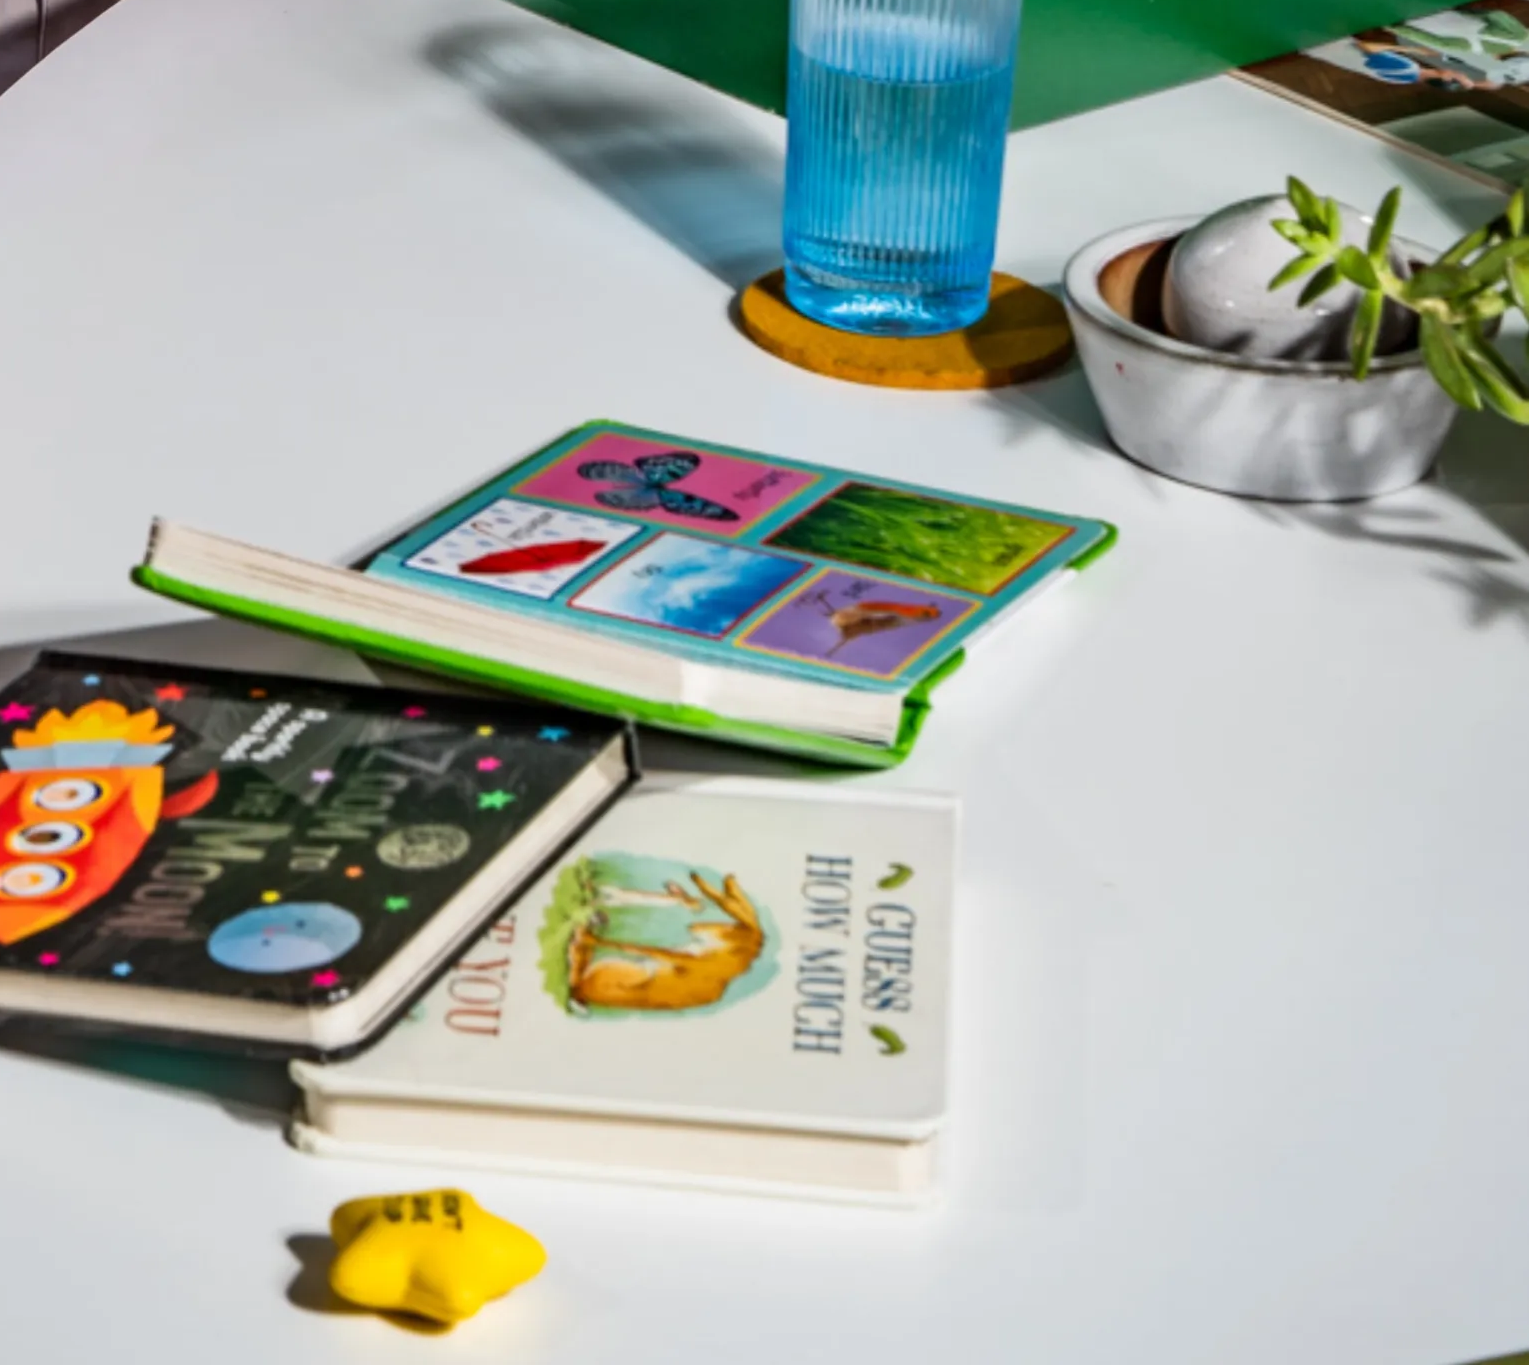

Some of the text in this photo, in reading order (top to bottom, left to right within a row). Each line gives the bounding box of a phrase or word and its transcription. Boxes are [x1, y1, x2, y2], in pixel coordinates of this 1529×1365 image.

[444, 954, 512, 1037] YOU
[793, 853, 853, 1055] HOW MUCH
[861, 901, 917, 1014] GUESS
